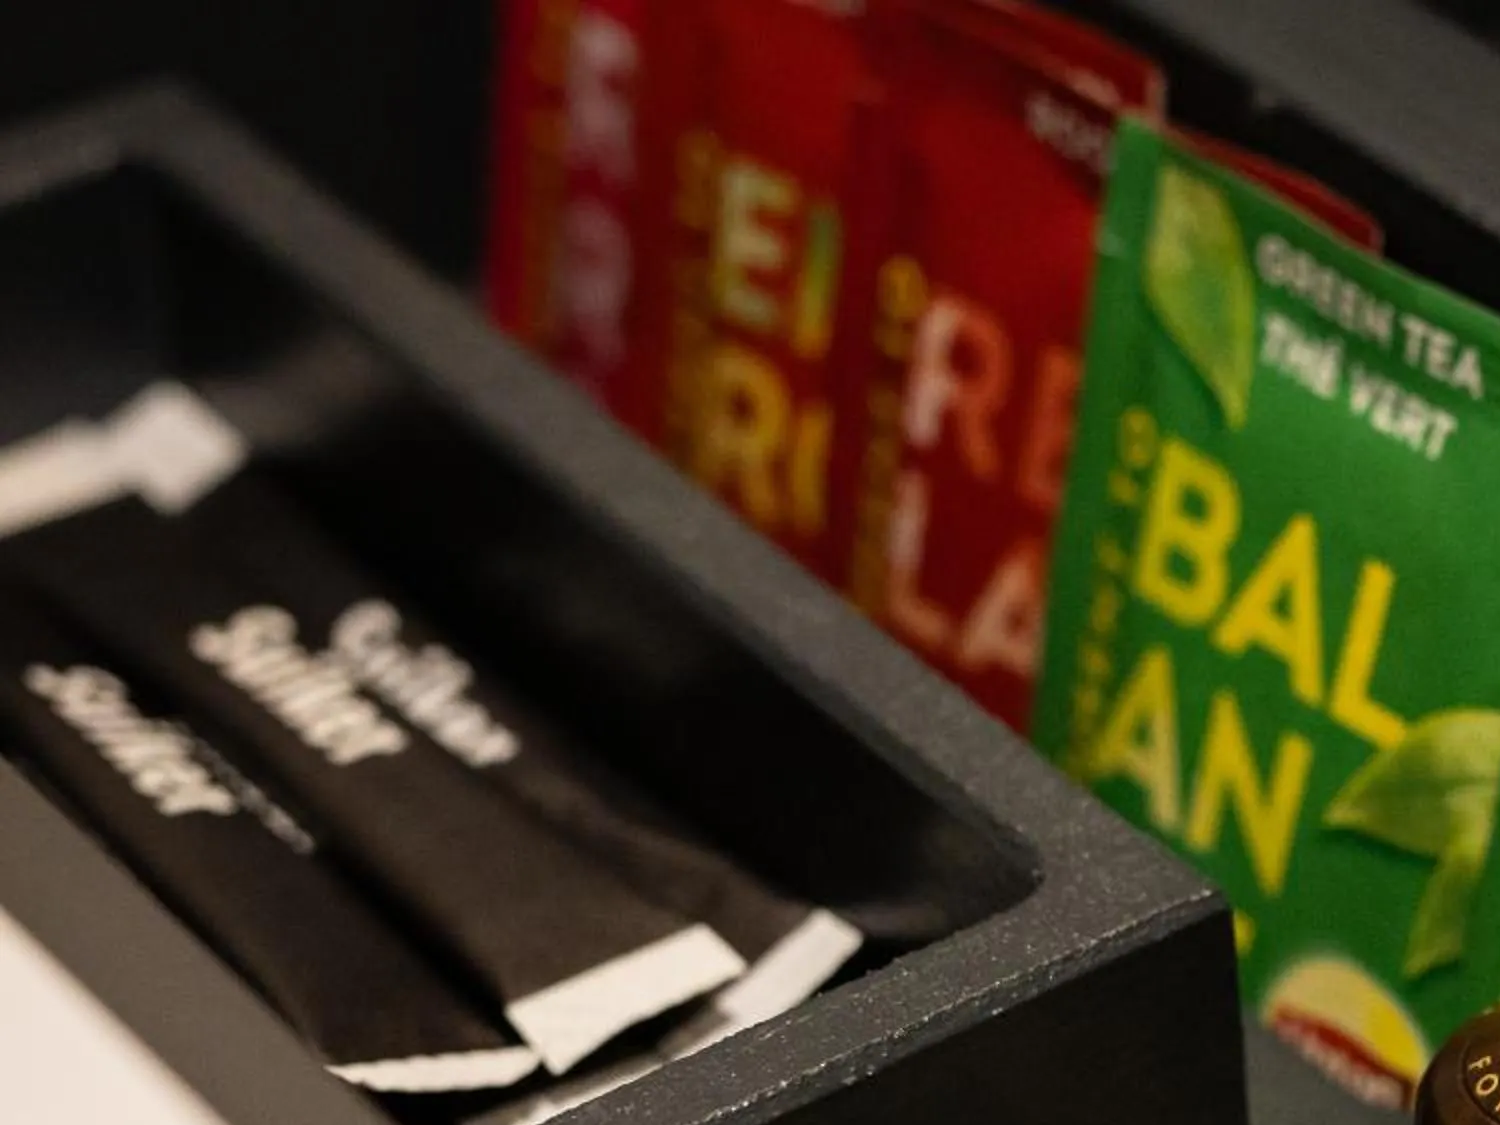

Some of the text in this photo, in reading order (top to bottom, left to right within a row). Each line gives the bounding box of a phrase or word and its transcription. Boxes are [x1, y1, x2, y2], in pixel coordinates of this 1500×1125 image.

[1255, 232, 1486, 402] GREEN TEA
[1349, 361, 1460, 462] VERT
[1133, 436, 1408, 750] BAL
[1092, 646, 1314, 896] AN
